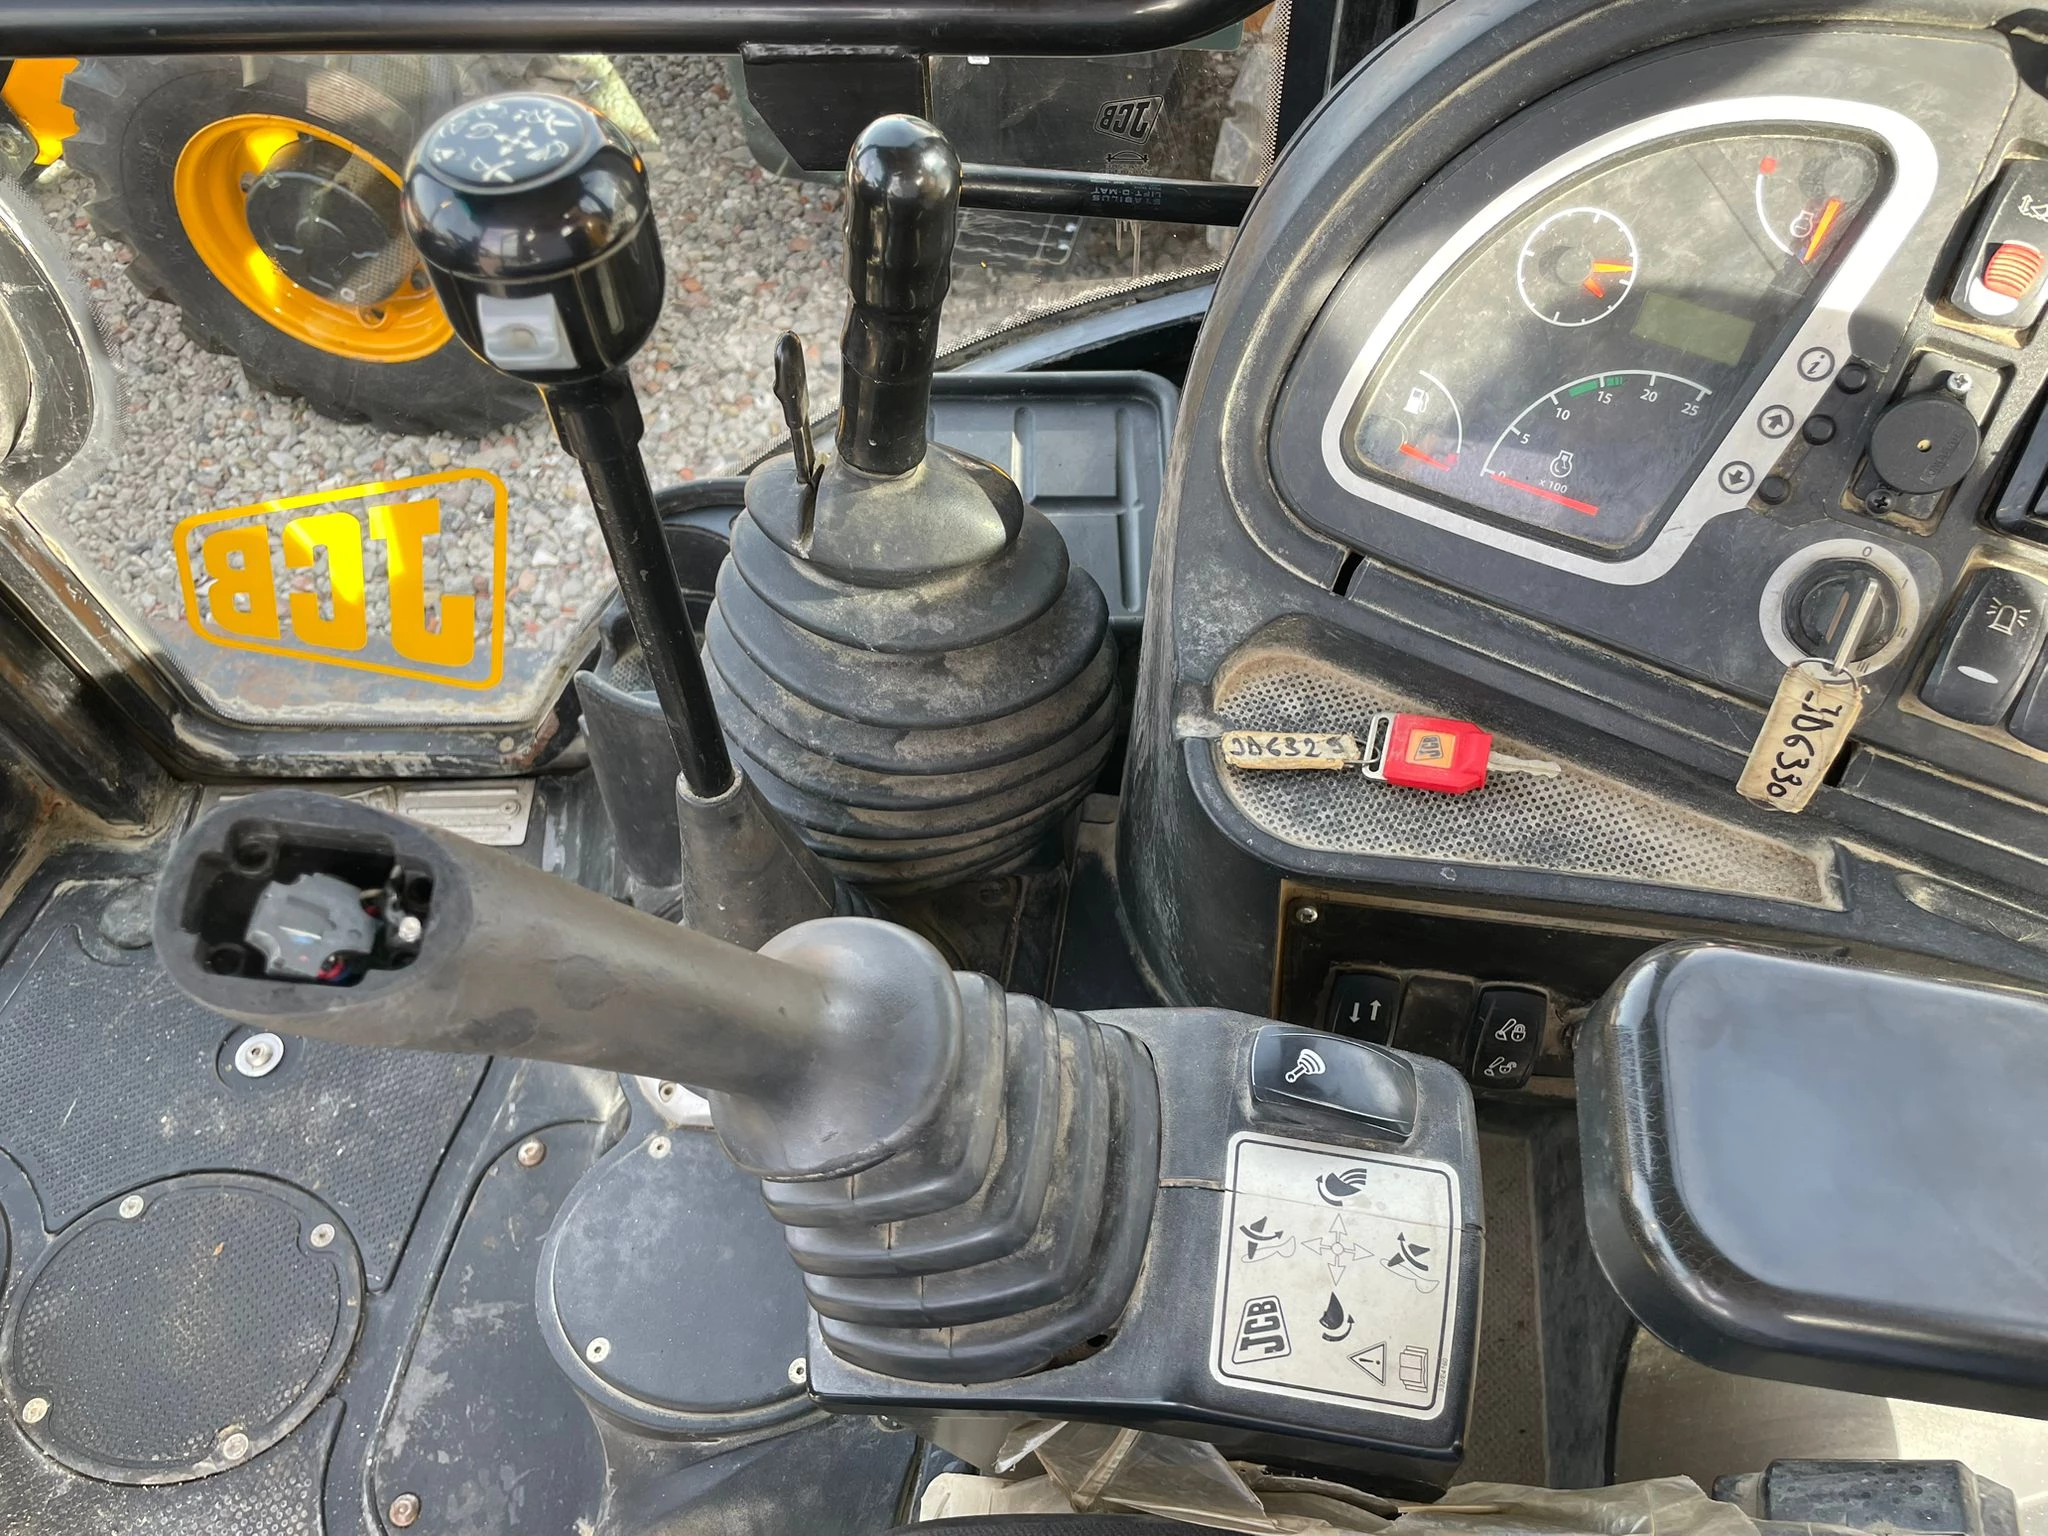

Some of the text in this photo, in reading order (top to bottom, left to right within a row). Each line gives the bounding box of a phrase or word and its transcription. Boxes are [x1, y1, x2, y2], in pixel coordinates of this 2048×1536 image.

[1597, 391, 1613, 406] 15
[1640, 388, 1658, 403] 20
[1554, 407, 1571, 421] 10
[1681, 402, 1700, 417] 25
[1519, 433, 1531, 445] 5
[1548, 479, 1568, 494] 100
[1417, 735, 1442, 758] JCB
[1239, 1300, 1286, 1354] JCB
